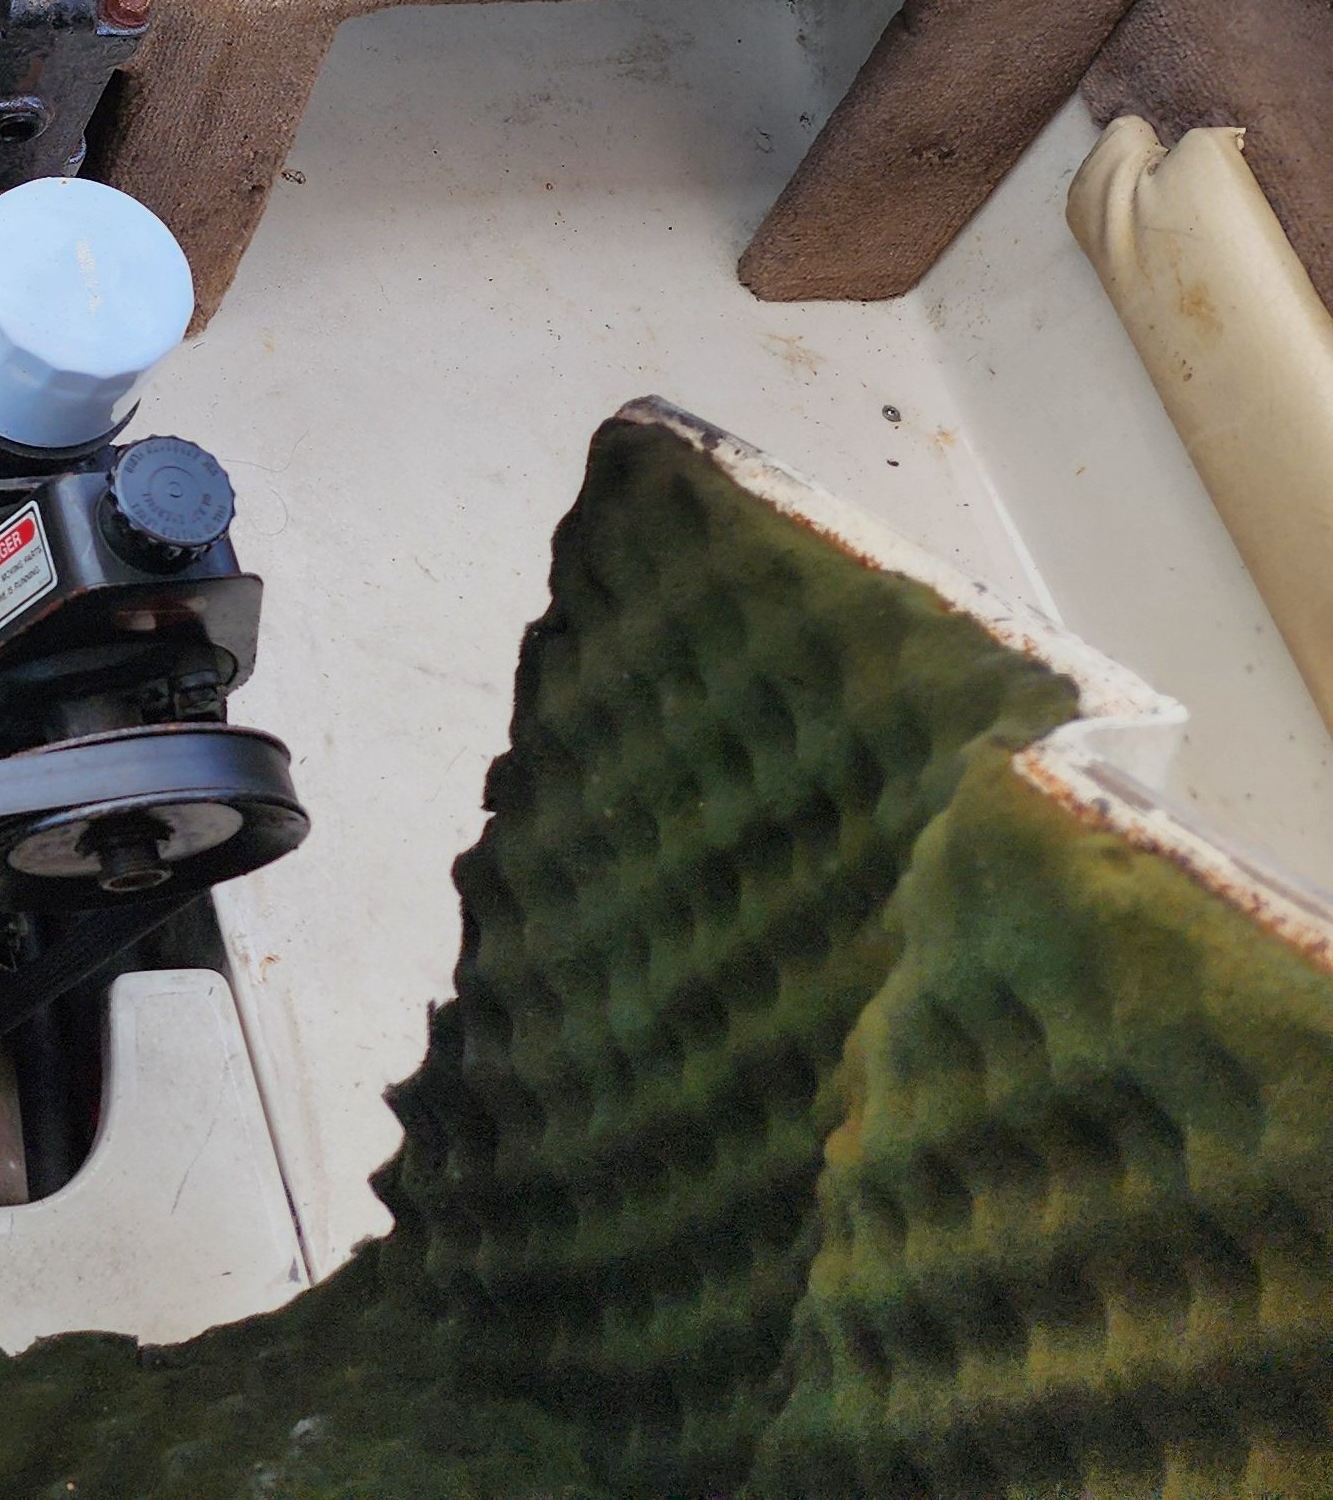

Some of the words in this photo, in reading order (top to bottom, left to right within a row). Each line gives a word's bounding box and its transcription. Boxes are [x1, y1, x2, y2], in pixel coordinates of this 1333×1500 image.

[1, 563, 24, 582] MOVING
[24, 545, 42, 564] PARTS
[7, 586, 14, 595] IS
